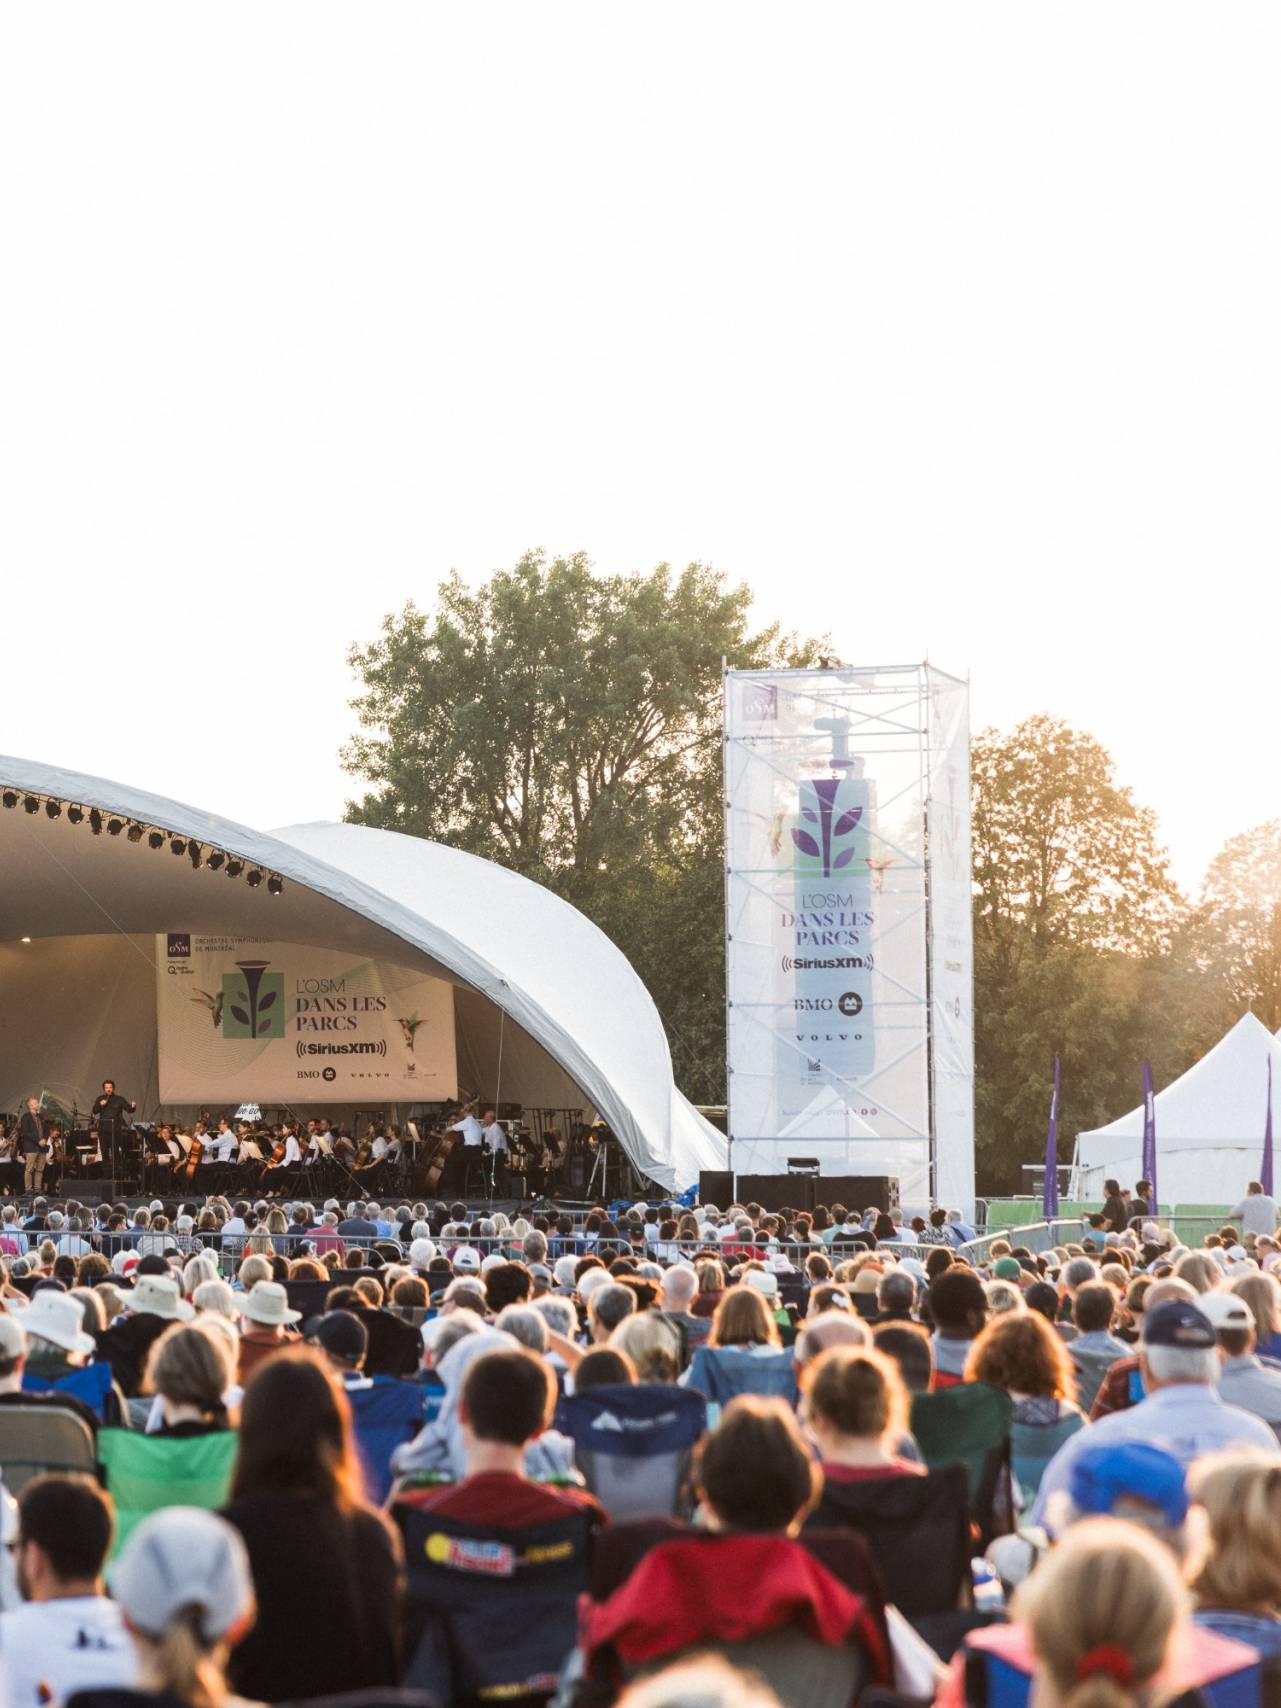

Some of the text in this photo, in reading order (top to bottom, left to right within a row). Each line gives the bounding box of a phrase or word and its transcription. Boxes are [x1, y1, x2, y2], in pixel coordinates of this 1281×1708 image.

[803, 894, 853, 909] L'OSM
[782, 911, 875, 927] DANS LES
[796, 930, 860, 946] PARCS
[169, 941, 189, 953] OSM
[296, 979, 346, 993] L'OSM
[296, 996, 387, 1013] DANS LES
[794, 999, 834, 1011] BMO
[296, 1016, 358, 1031] PARCS
[796, 1033, 863, 1041] VOLVO
[297, 1071, 320, 1079] BMO
